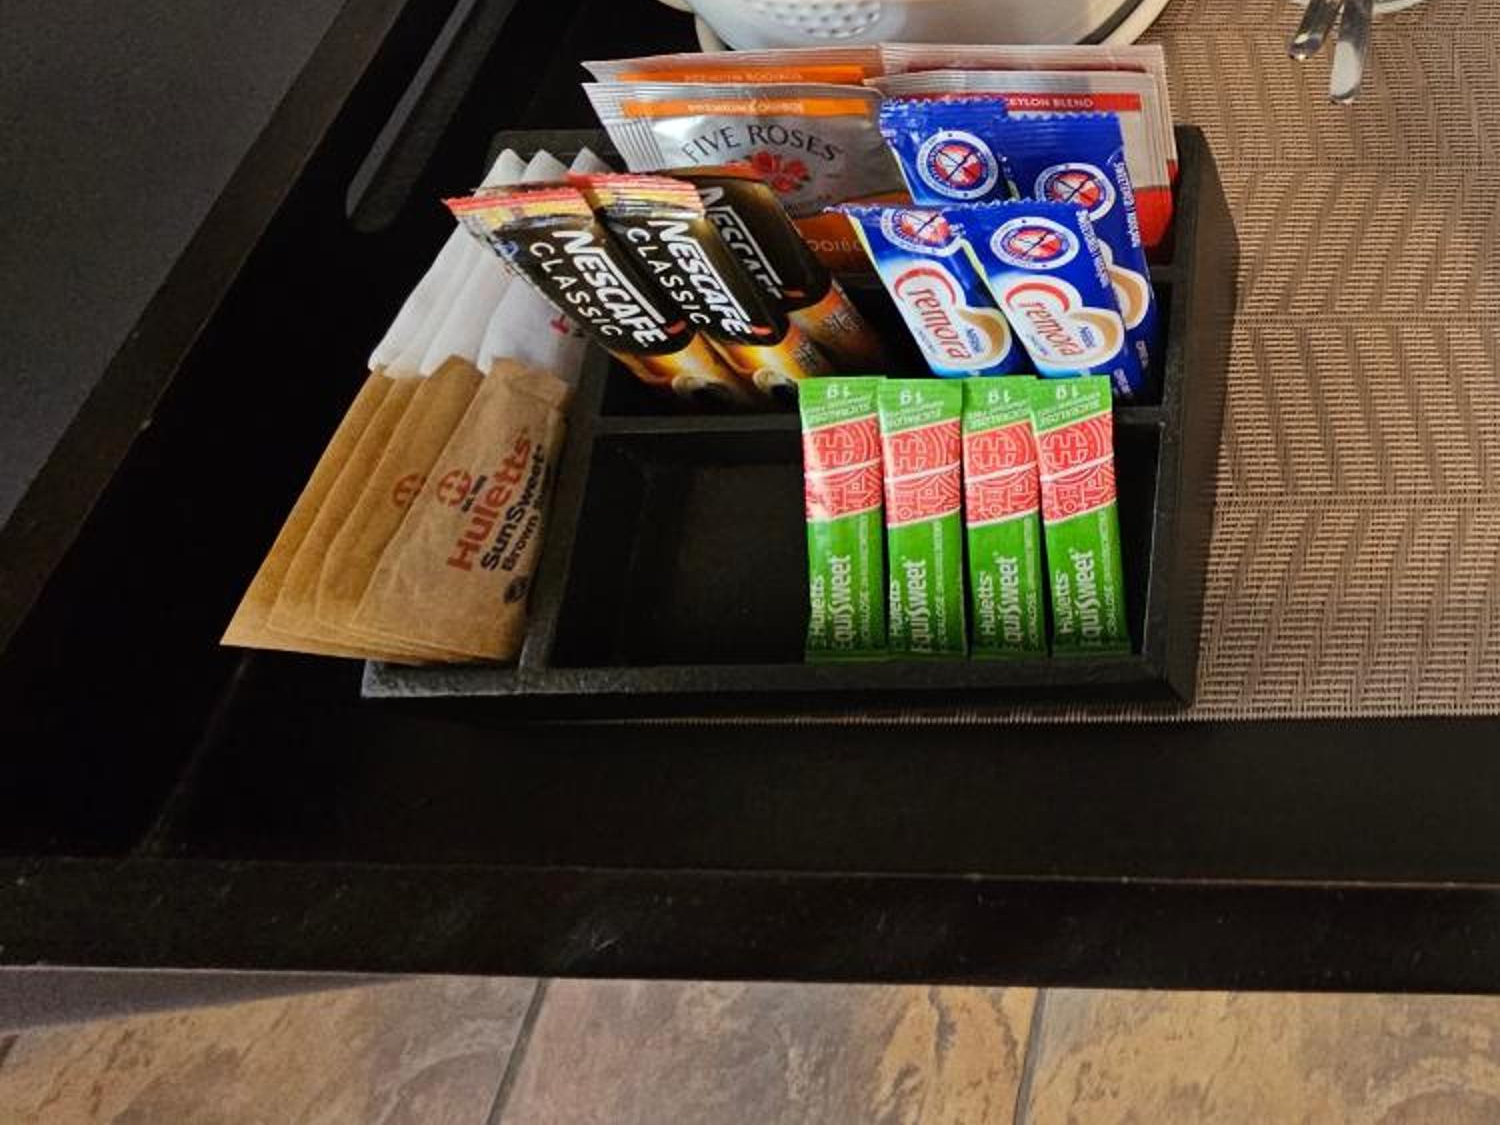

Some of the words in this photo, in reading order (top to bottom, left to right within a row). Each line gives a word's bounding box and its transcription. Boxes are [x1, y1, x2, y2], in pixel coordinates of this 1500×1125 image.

[1052, 97, 1094, 109] BLEND
[681, 125, 741, 164] FIVE
[750, 125, 838, 162] ROSES
[529, 241, 623, 336] CLASSIC
[626, 227, 711, 325] CLASSIC
[446, 434, 531, 571] Huletts
[480, 447, 545, 572] SunSweet
[977, 575, 996, 636] Huletts
[1055, 572, 1074, 636] Huletts
